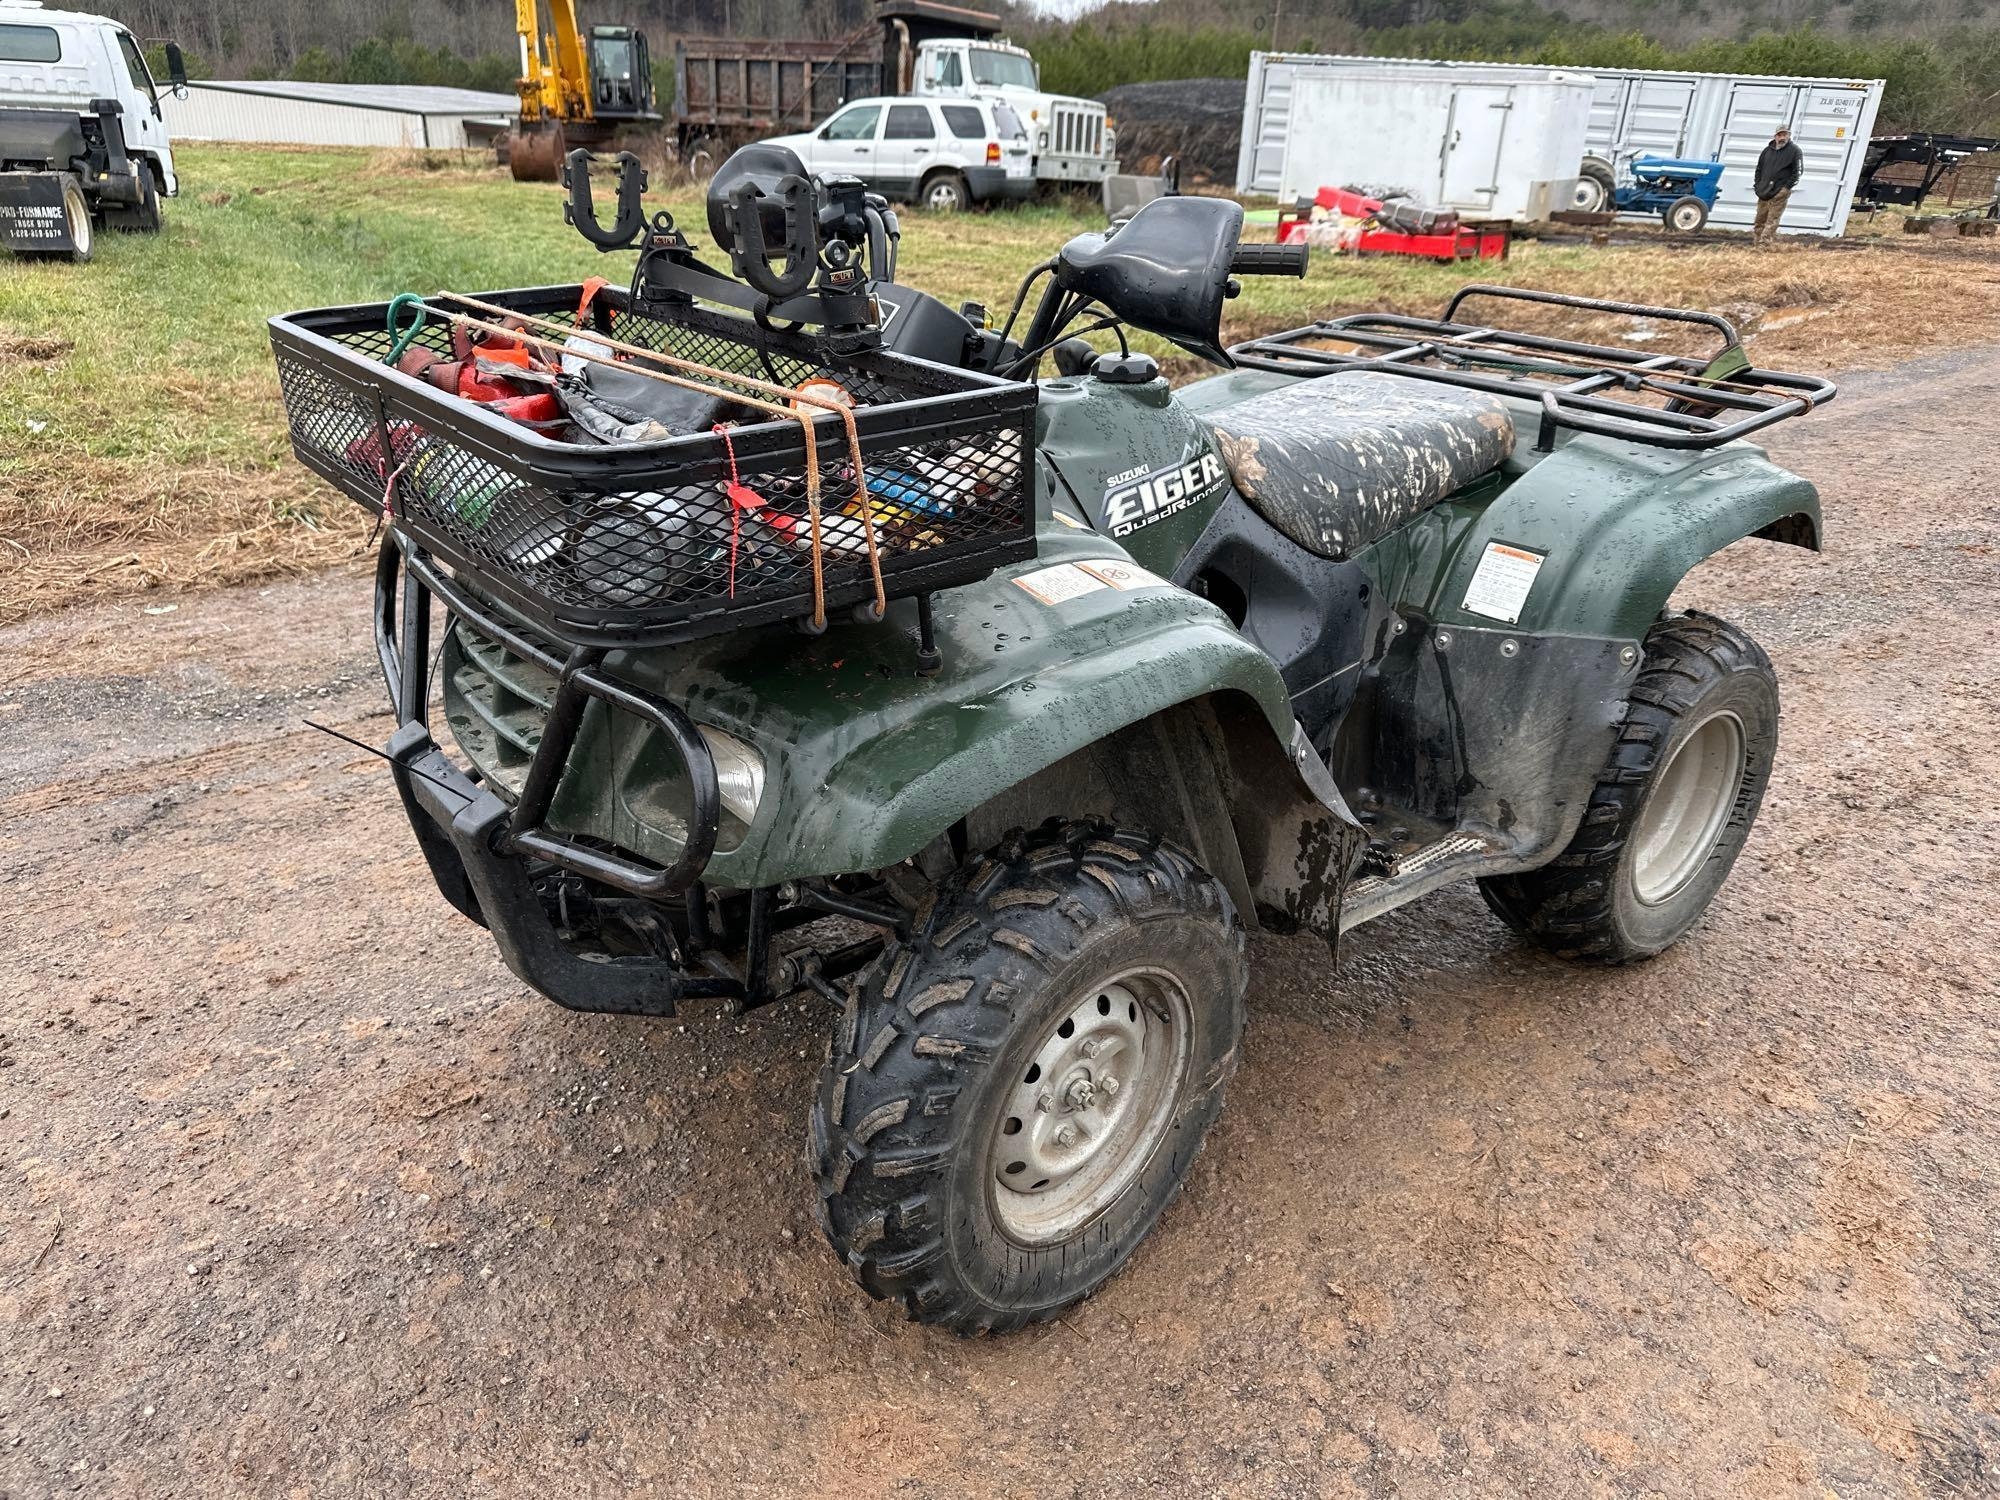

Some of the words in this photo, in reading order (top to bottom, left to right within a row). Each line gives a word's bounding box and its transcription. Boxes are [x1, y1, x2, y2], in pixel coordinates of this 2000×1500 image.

[15, 219, 35, 228] TRUCK
[37, 219, 53, 228] BODY
[1106, 463, 1151, 488] SUZUKI
[1105, 452, 1224, 529] EIGER
